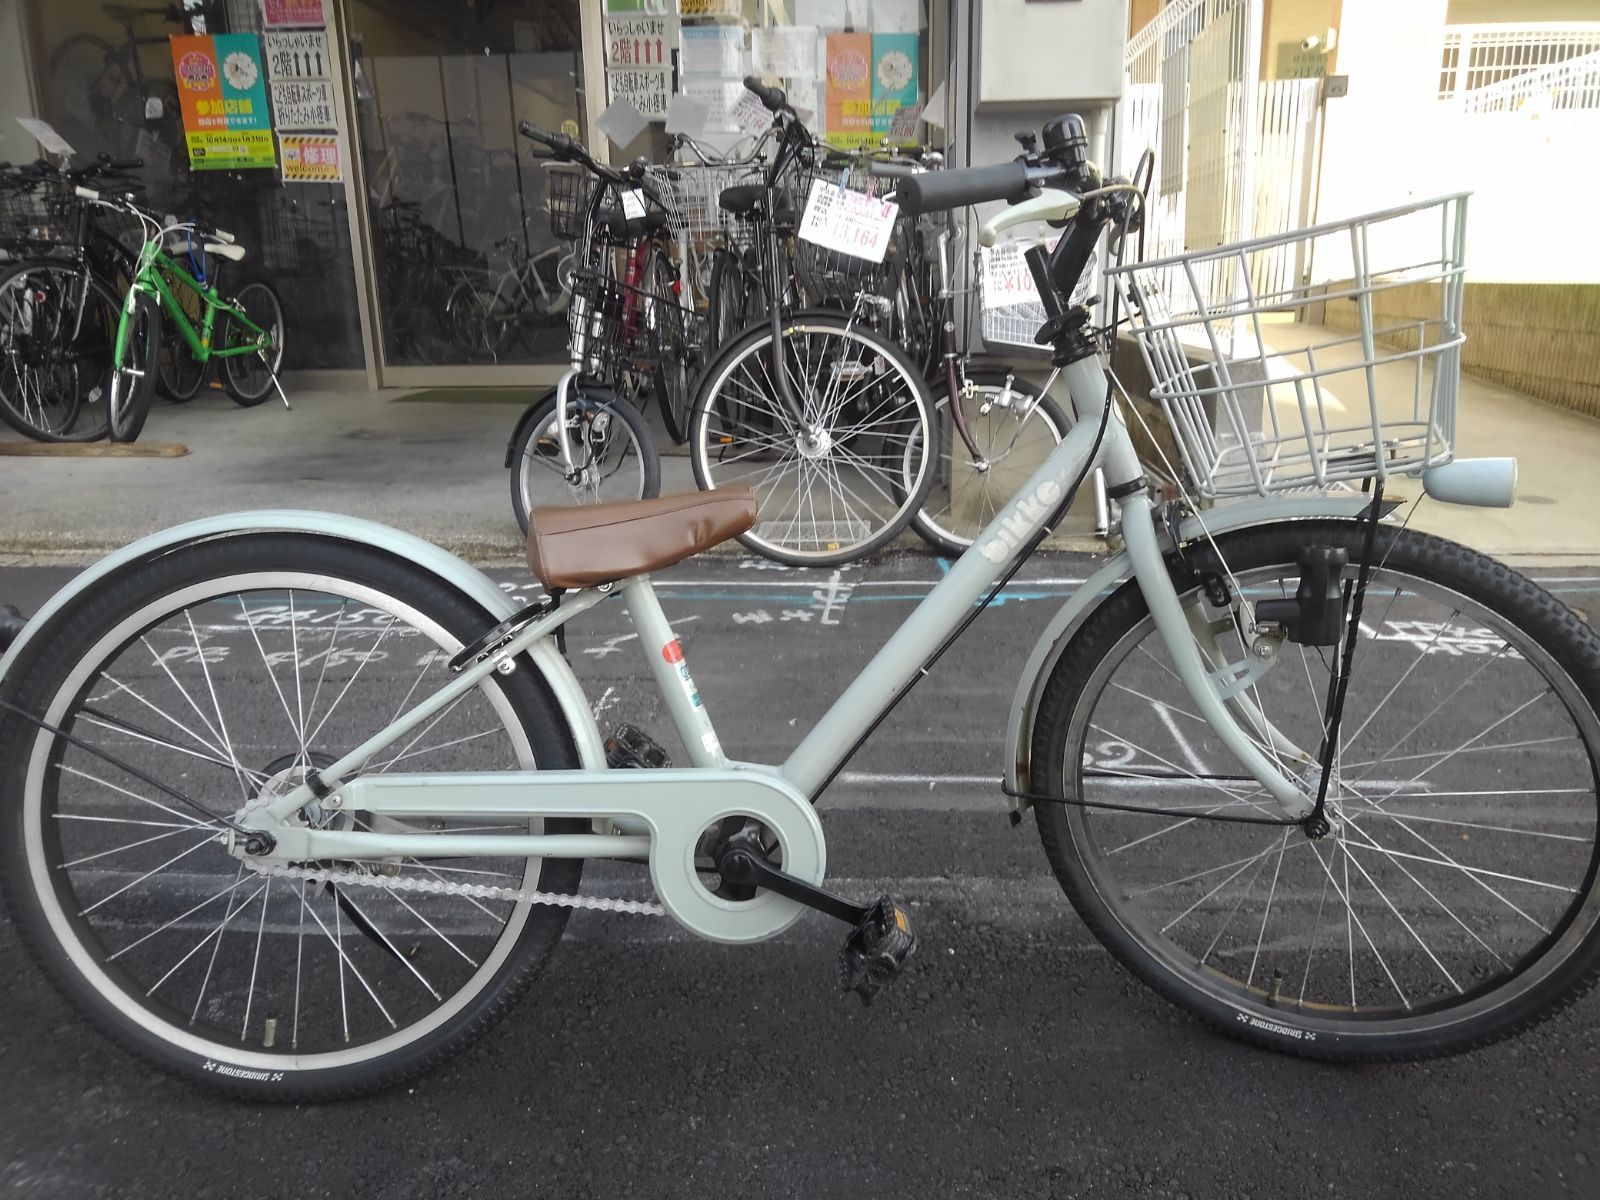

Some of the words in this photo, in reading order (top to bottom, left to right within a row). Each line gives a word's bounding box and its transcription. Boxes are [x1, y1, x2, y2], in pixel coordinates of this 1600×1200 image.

[608, 20, 665, 36] いらっしゃいませ
[267, 32, 322, 48] いらっしゃいませ
[611, 38, 632, 65] 2階
[272, 50, 293, 77] 2階
[611, 71, 665, 93] こども自転車スポーツ車
[273, 83, 327, 105] こども自転車スポーツ車
[278, 105, 332, 126] 折りたたみ小径車
[303, 146, 338, 165] 修理
[286, 163, 330, 173] welcome
[832, 223, 880, 249] 13,164
[978, 480, 1061, 563] bikke
[1249, 1017, 1303, 1039] BRIDGESTONE
[216, 1064, 271, 1082] BRIDGESTONE
